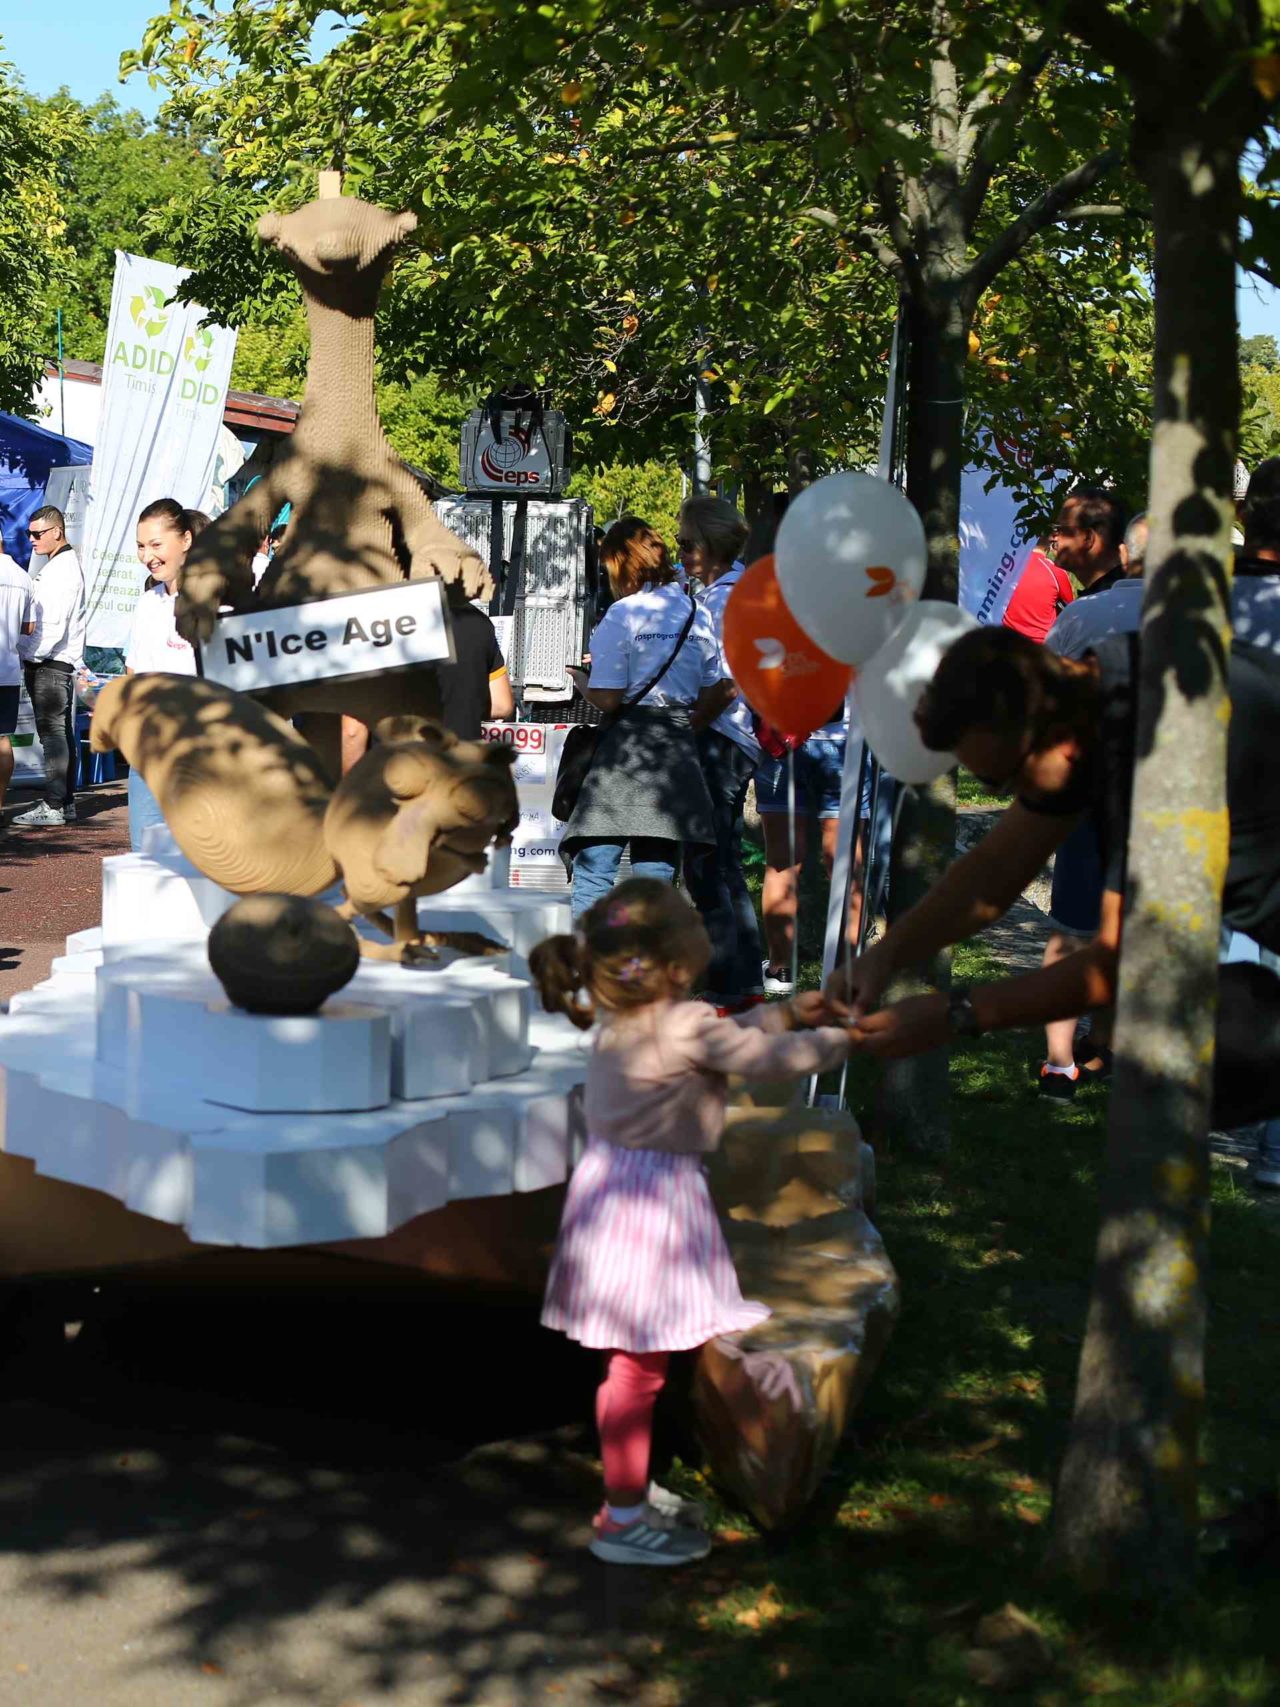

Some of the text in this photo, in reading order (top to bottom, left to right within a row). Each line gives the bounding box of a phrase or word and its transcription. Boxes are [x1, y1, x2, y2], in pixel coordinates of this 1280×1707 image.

[112, 340, 175, 375] ADID
[503, 470, 540, 486] eps
[224, 615, 417, 665] N'Ice Age
